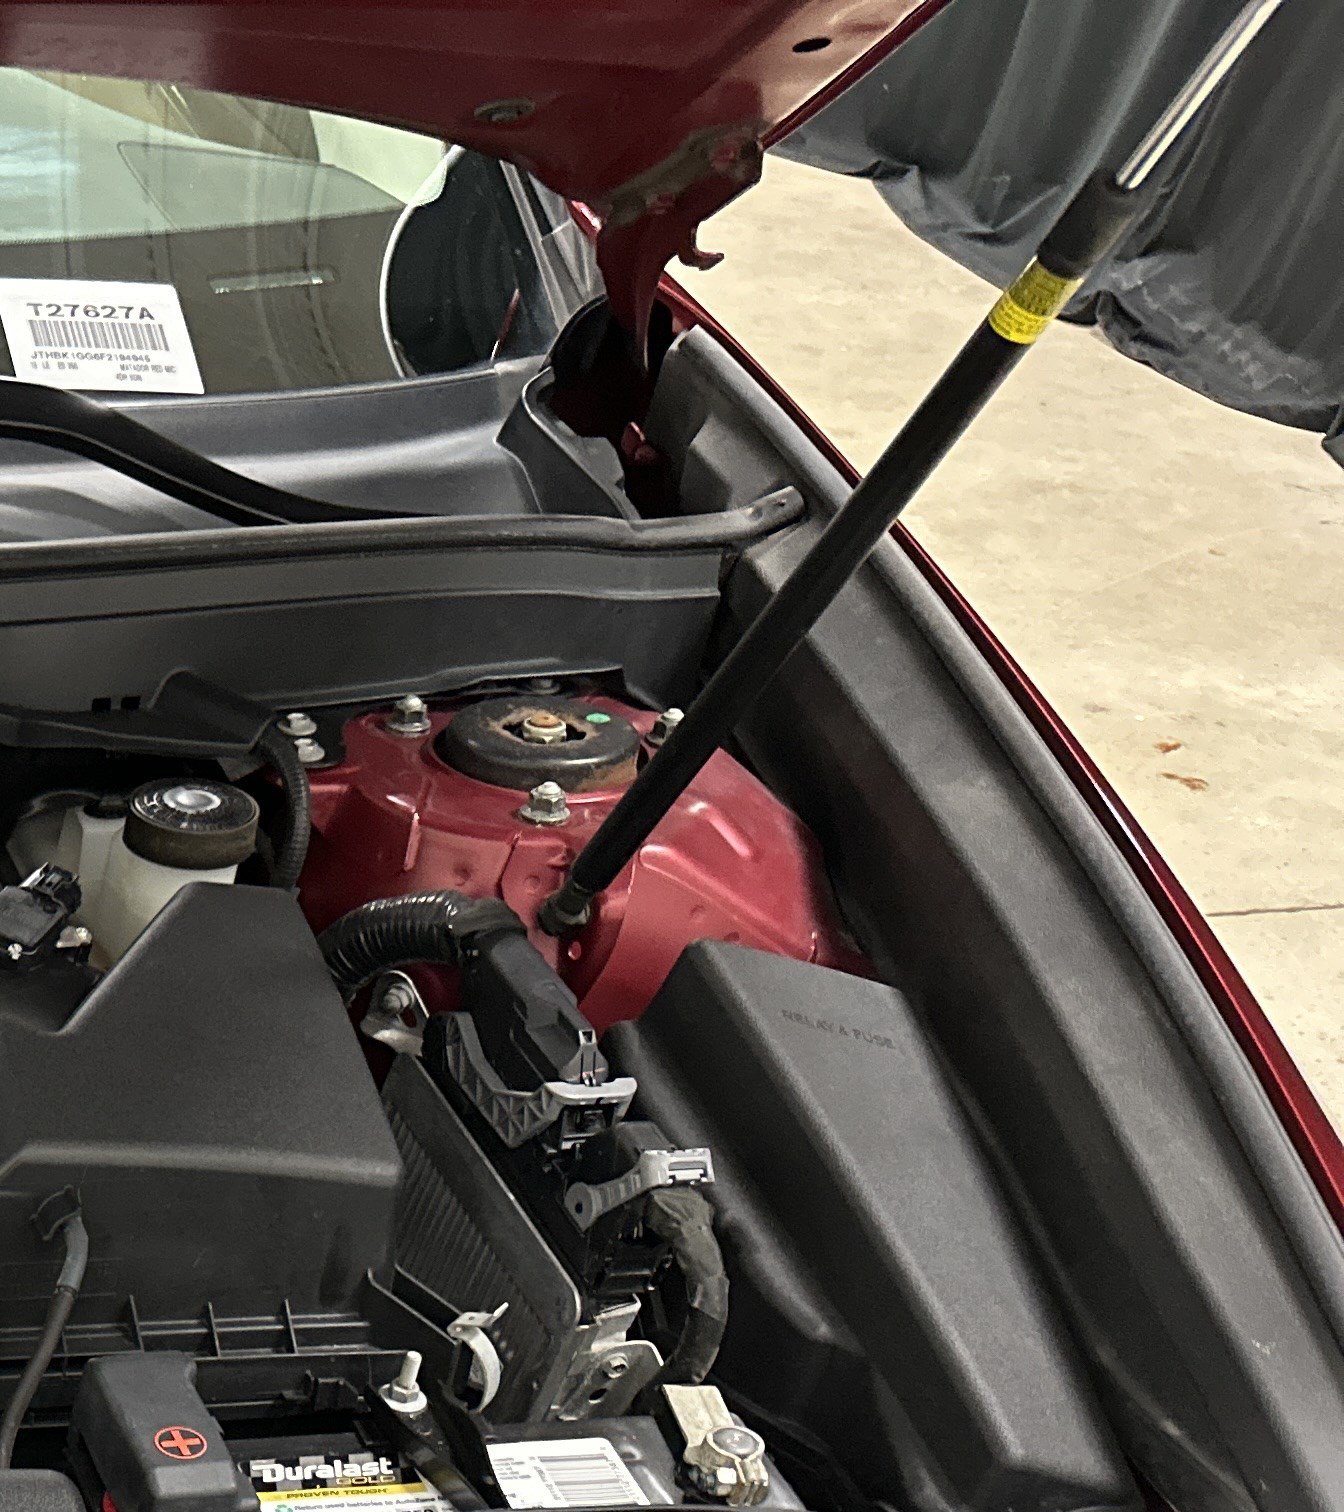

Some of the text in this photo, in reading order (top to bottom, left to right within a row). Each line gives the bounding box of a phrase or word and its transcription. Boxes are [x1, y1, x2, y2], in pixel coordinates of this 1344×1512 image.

[26, 302, 155, 321] T27627A
[252, 1457, 394, 1483] Duralast
[335, 1475, 396, 1486] GOLD
[286, 1487, 388, 1499] PROVEN TOUGH
